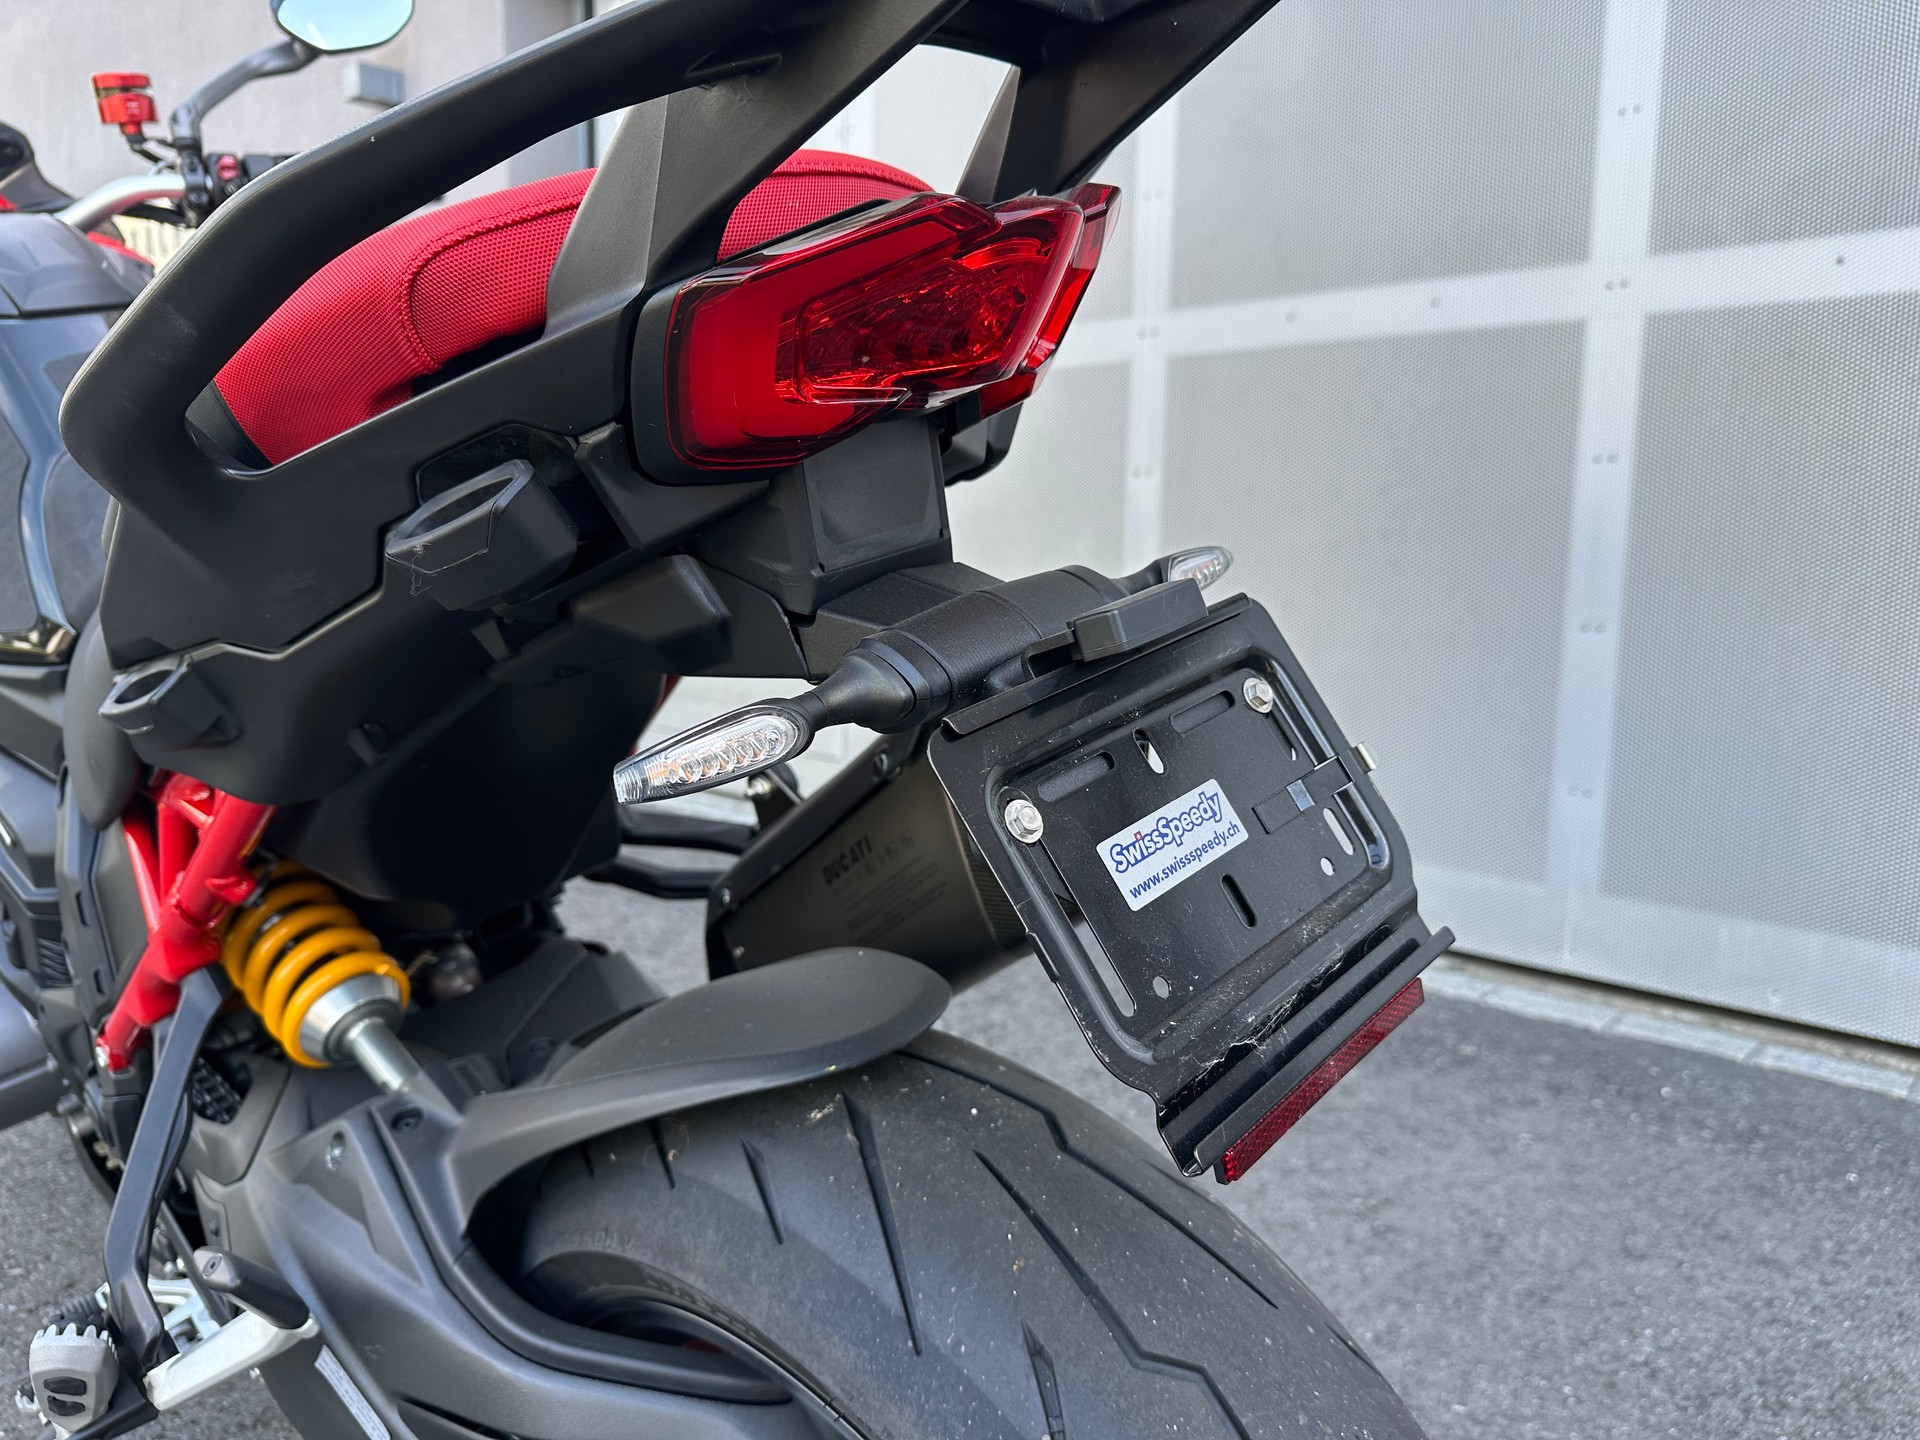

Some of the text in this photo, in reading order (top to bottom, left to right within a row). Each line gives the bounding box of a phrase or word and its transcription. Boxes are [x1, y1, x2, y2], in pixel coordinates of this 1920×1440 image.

[822, 834, 872, 886] DUCATI
[1110, 791, 1222, 873] SwissSpeedy
[1129, 821, 1240, 898] www.swissspeedy.ch
